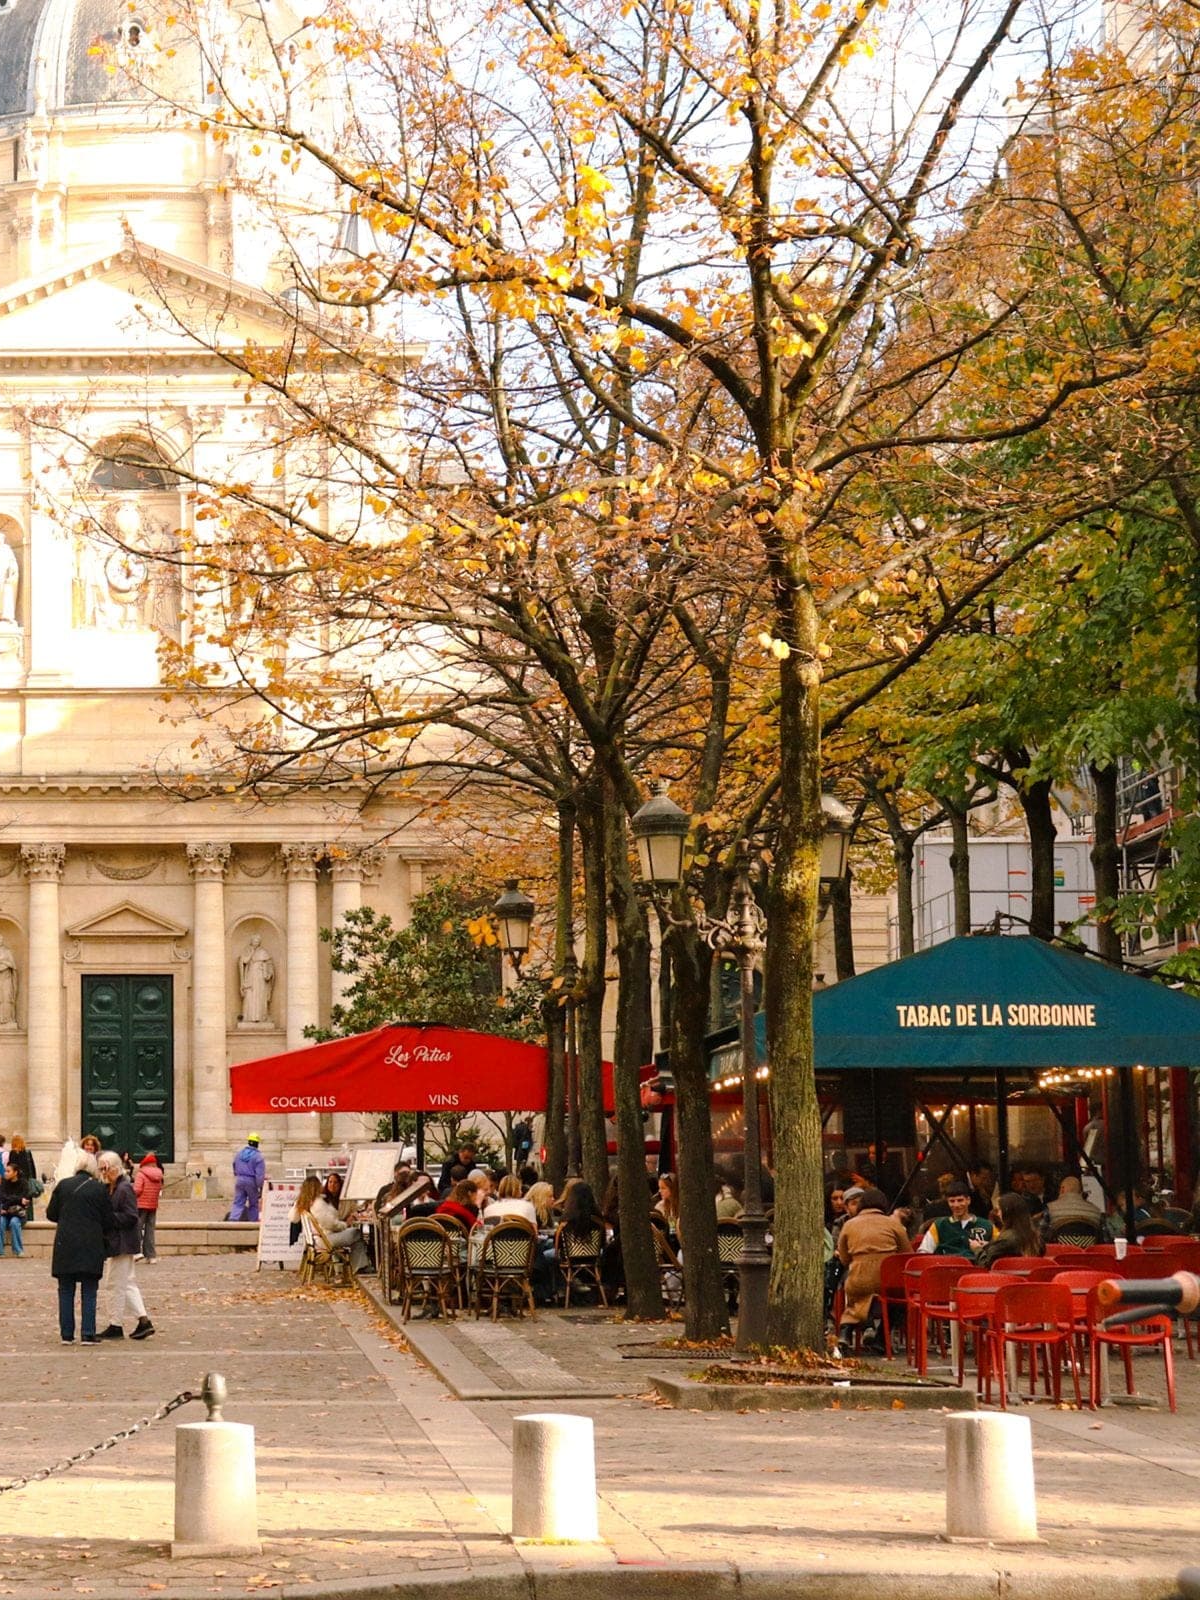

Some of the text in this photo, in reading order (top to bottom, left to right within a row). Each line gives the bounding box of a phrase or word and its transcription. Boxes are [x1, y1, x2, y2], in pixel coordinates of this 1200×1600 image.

[896, 1004, 1096, 1027] TABAC DE LA SORBONNE
[384, 1045, 453, 1068] Les Patios
[270, 1095, 337, 1108] COCKTAILS
[428, 1094, 459, 1106] VINS
